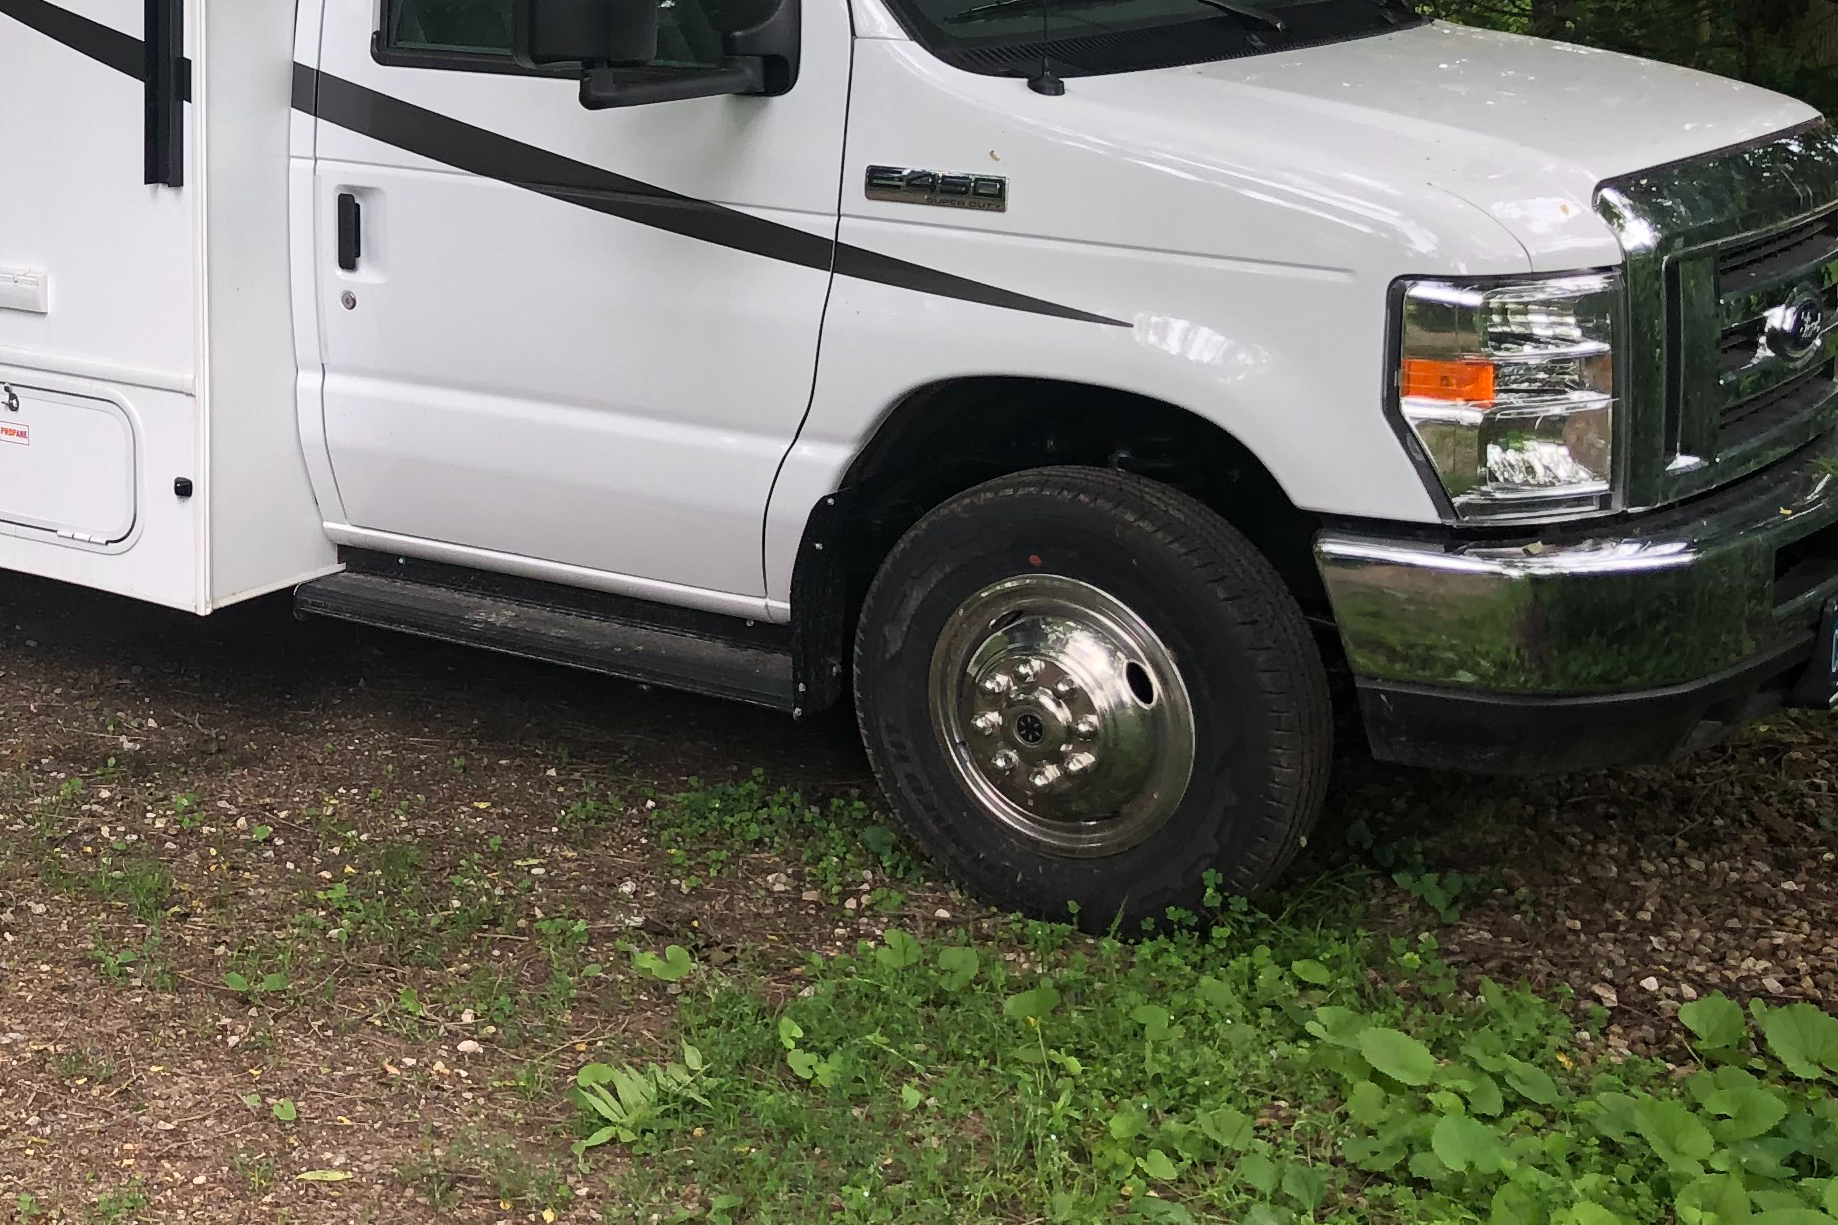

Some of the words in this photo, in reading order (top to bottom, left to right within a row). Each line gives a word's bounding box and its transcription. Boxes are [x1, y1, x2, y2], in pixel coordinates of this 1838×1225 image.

[925, 197, 965, 207] SUPER
[968, 200, 1002, 209] DUTY
[1, 427, 28, 438] PROPANE
